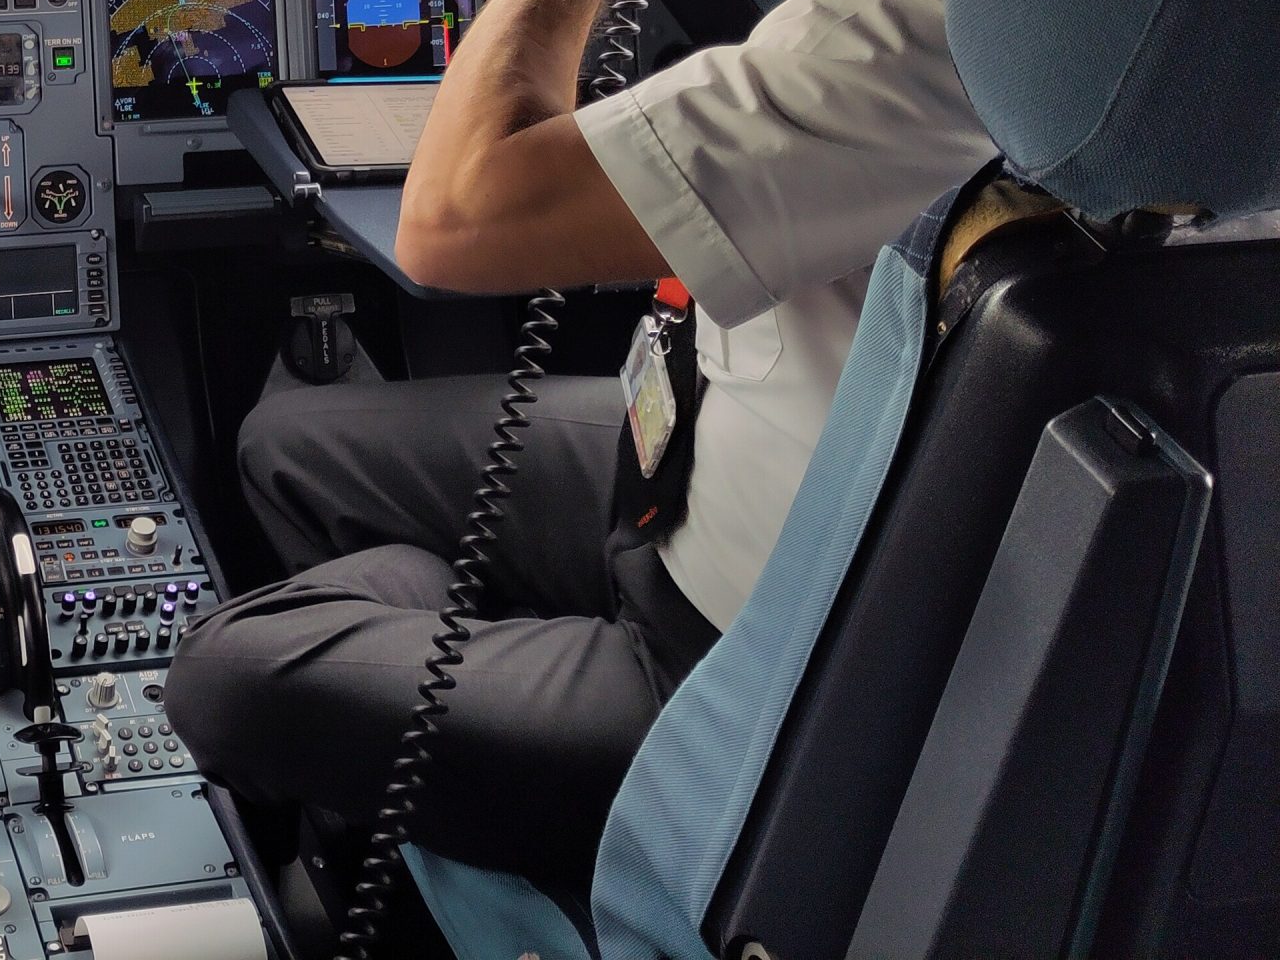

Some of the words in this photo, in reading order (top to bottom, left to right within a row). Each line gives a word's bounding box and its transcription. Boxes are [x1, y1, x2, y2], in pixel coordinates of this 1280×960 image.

[8, 65, 19, 75] 39
[313, 297, 332, 305] PULL
[321, 321, 329, 365] PEDALS
[121, 832, 155, 842] FLAPS
